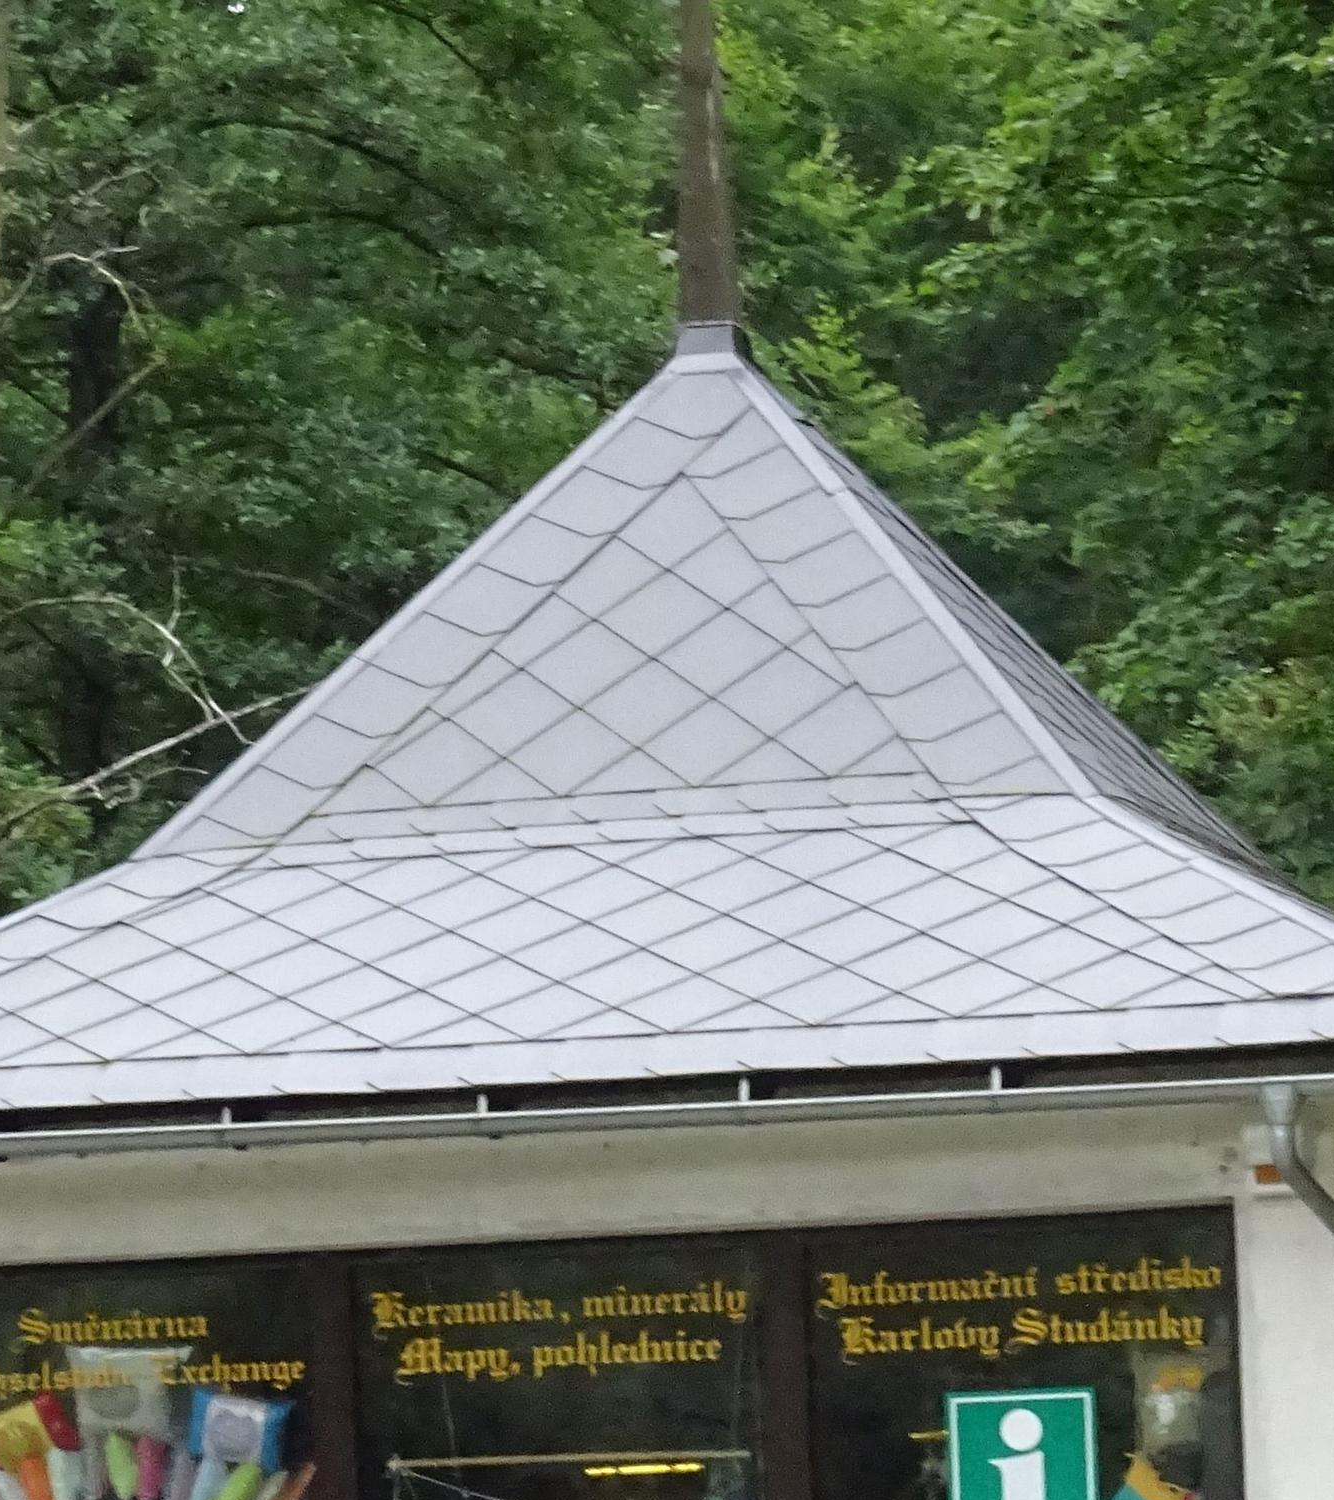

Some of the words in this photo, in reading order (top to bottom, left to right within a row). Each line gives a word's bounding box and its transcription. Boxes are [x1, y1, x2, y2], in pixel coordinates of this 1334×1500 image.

[581, 1279, 749, 1324] minerály
[819, 1266, 1038, 1310] Informační
[1054, 1256, 1223, 1296] středisko
[16, 1307, 210, 1345] Směnárna
[841, 1315, 1001, 1360] Karlovy
[1011, 1306, 1205, 1347] Studánky
[153, 1353, 307, 1393] Exchange
[396, 1336, 522, 1381] Mapy,
[532, 1329, 723, 1378] pohlednice
